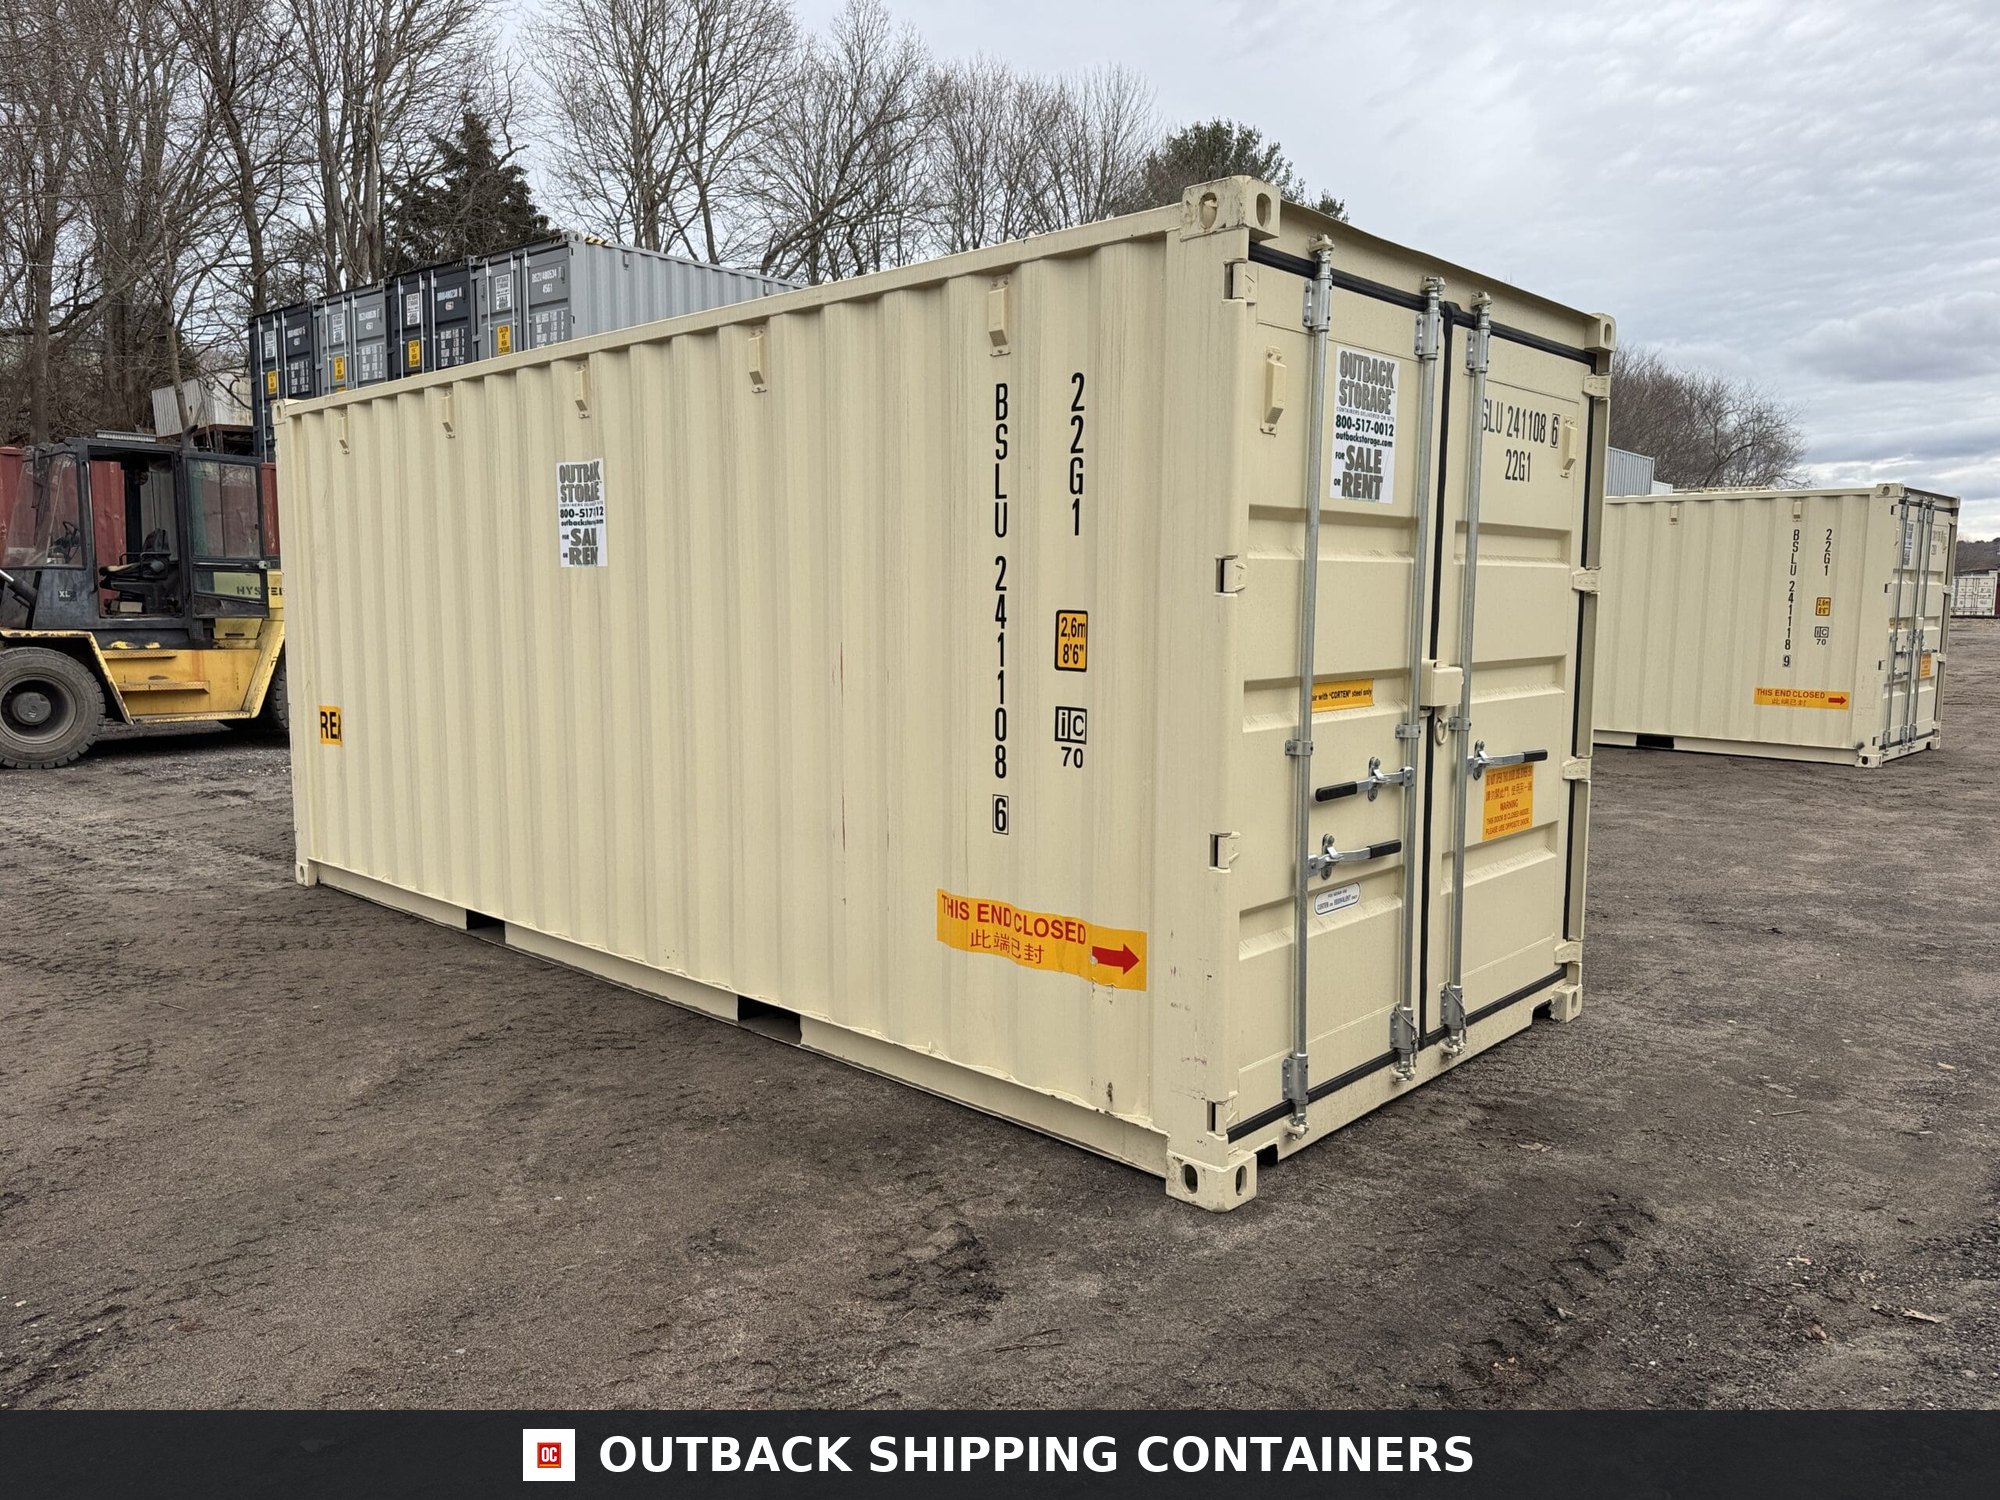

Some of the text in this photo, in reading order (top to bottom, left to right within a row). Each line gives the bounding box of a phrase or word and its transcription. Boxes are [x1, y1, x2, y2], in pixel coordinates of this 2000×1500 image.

[1340, 351, 1395, 389] OUTBACK
[1338, 378, 1392, 415] STORAGE
[1335, 414, 1394, 437] 800-517-0012
[1335, 431, 1393, 447] outbackstorage.com
[1483, 398, 1559, 446] SLU 241108 6
[994, 383, 1008, 538] BSLU
[1069, 372, 1085, 536] 22G1
[1335, 445, 1382, 474] FOR SALE
[1504, 448, 1531, 483] 22G1
[1333, 471, 1383, 500] OR RENT
[568, 546, 598, 565] REN
[1790, 529, 1800, 576] BSLU
[1823, 528, 1833, 576] 22G1
[59, 590, 71, 598] XL
[236, 585, 282, 596] HYSE
[1784, 580, 1795, 650] 241118
[994, 556, 1007, 779] 241108
[1757, 688, 1772, 697] THIS
[1792, 691, 1825, 699] CLOSED
[1060, 746, 1084, 769] 70
[1500, 799, 1518, 811] WARNING
[941, 894, 1086, 945] THIS END CLOSED
[970, 928, 1045, 964] 此端已封
